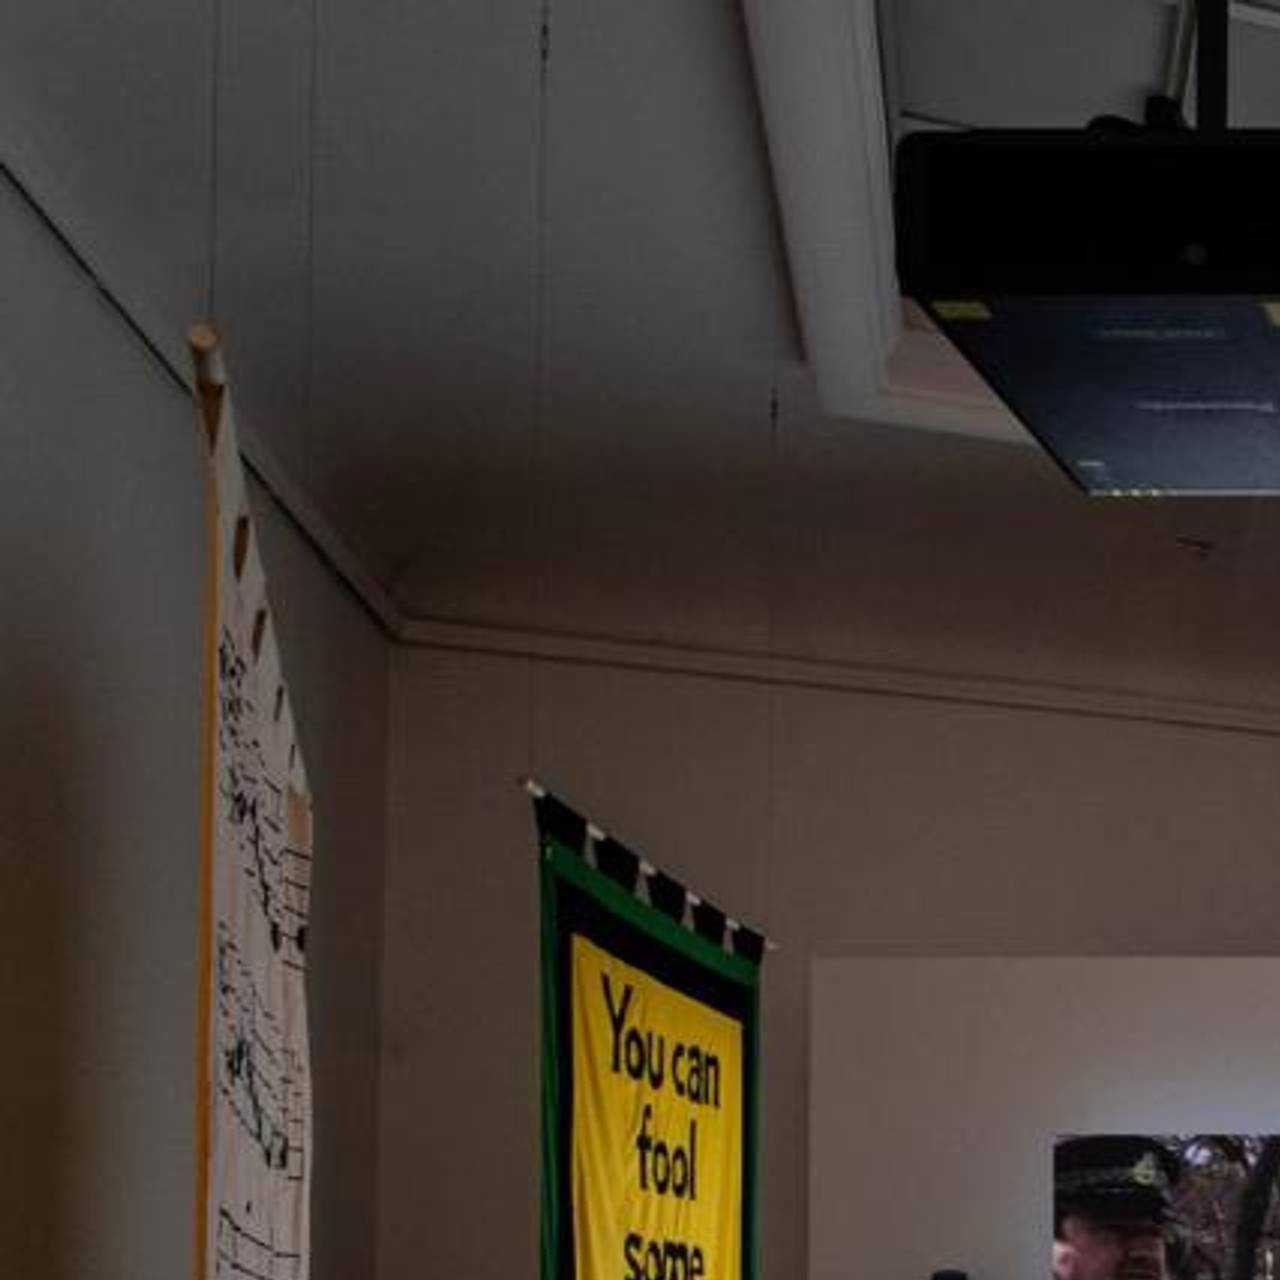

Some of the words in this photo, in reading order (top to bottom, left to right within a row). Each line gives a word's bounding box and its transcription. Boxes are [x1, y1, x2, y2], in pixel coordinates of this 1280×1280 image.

[602, 972, 664, 1090] You
[671, 1042, 721, 1109] can
[636, 1103, 697, 1201] fool
